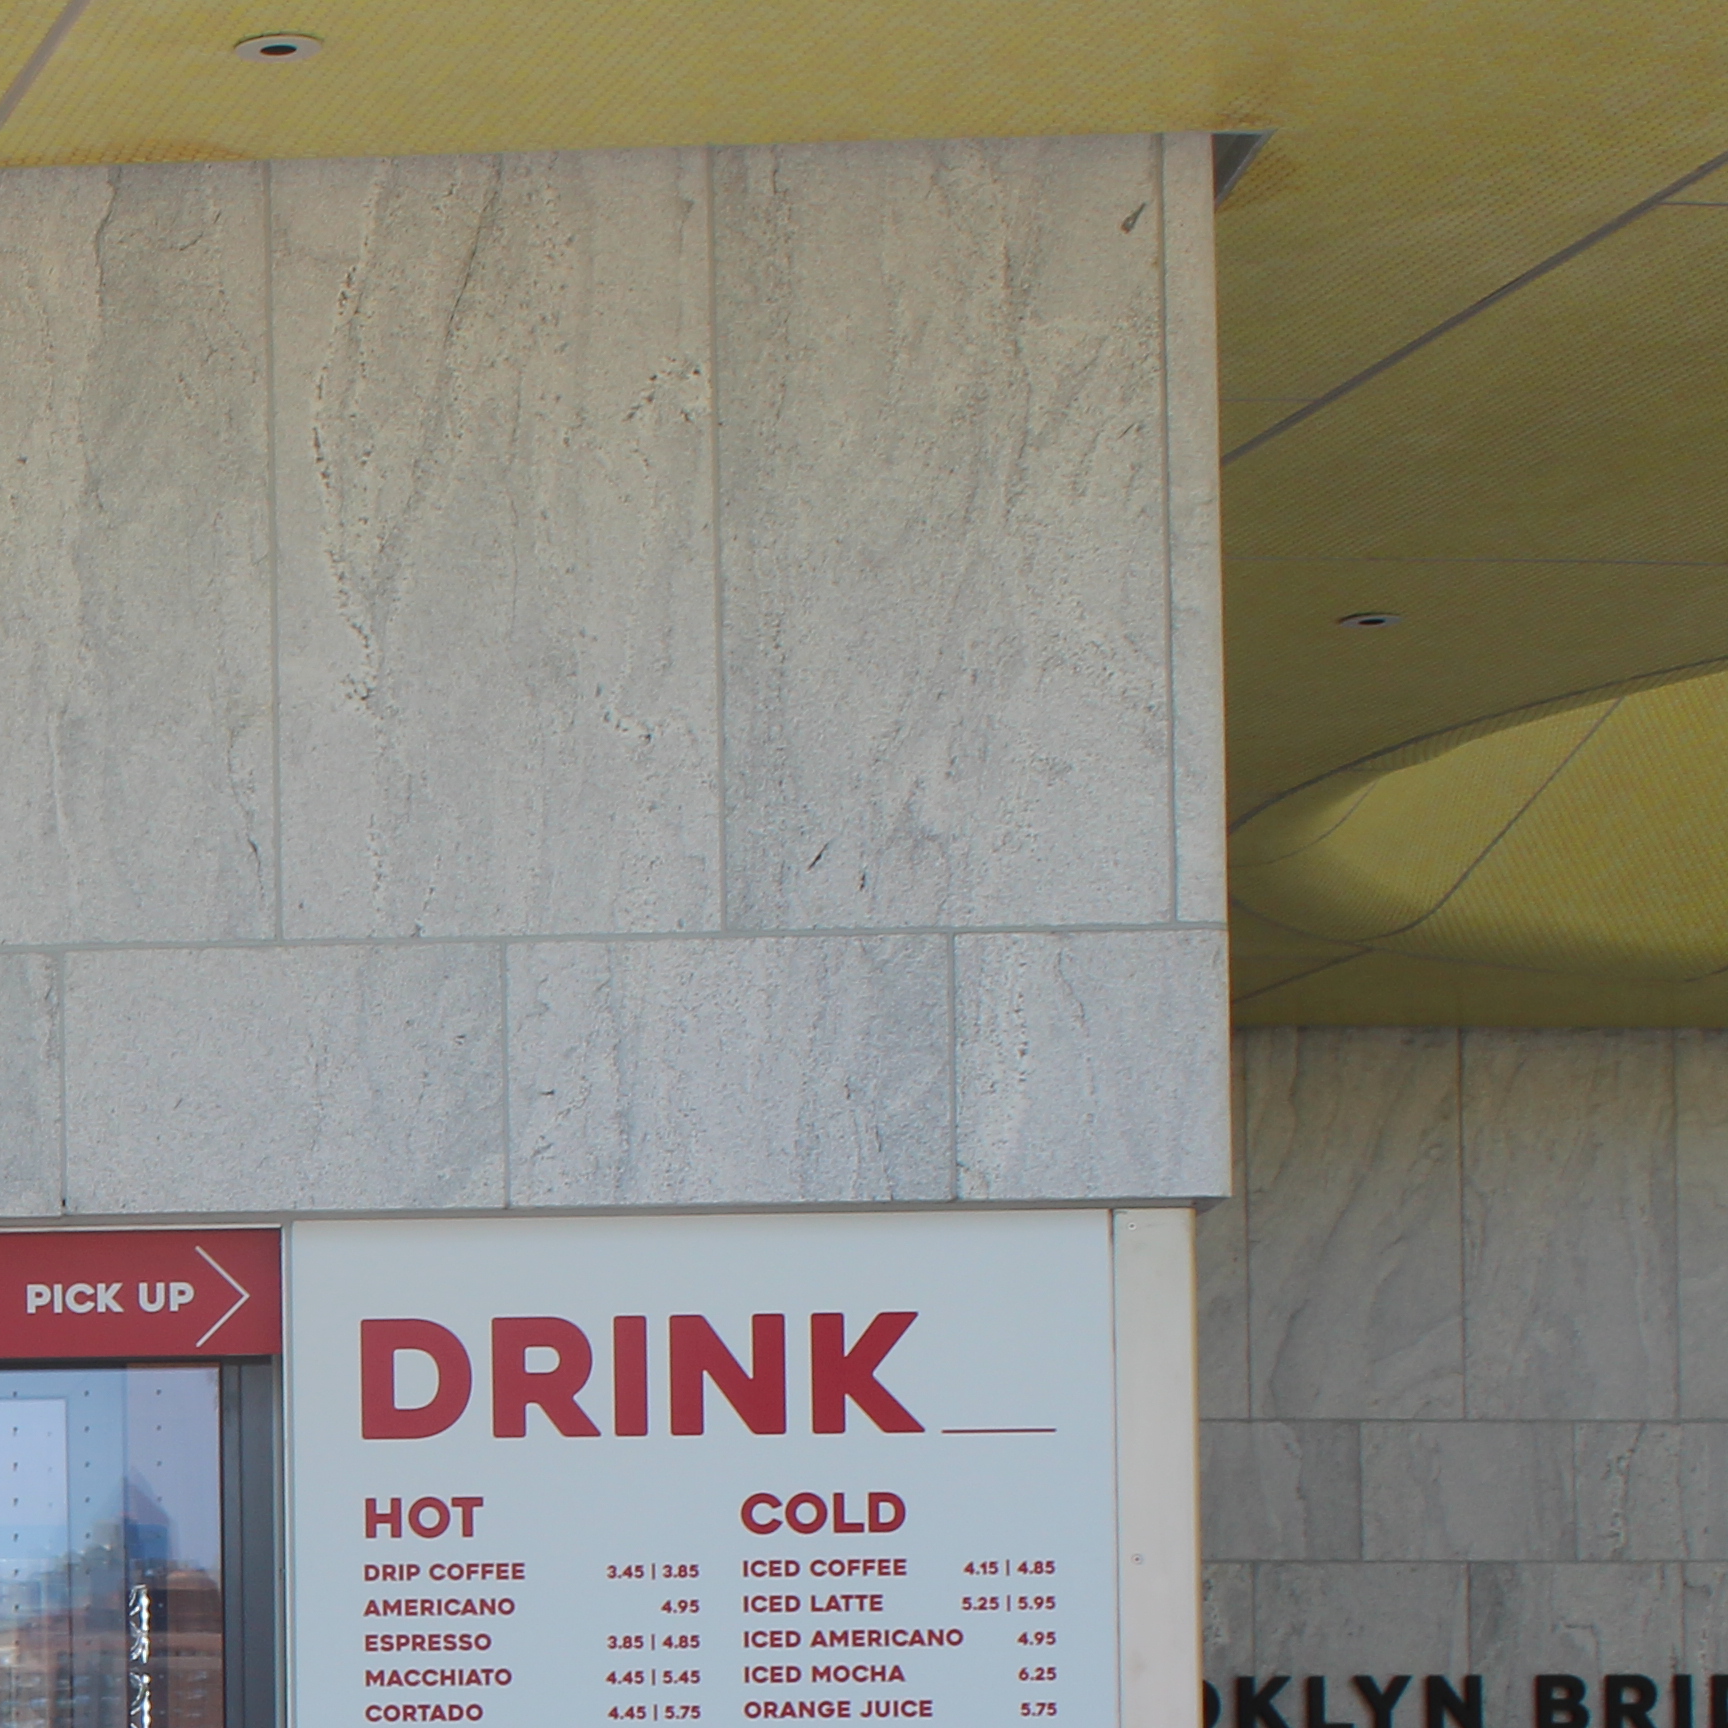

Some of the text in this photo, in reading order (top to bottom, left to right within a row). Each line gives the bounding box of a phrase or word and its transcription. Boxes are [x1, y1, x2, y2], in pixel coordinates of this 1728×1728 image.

[25, 1280, 195, 1314] PICK UP
[360, 1311, 926, 1440] DRINK
[364, 1496, 484, 1539] HOT
[740, 1491, 907, 1535] COLD
[364, 1562, 700, 1582] DRIP COFFEE 3.45 3.85
[743, 1558, 1056, 1578] ICED COFFEE 4.15 4.85
[363, 1597, 700, 1617] AMERICANO 4.95
[743, 1593, 1056, 1613] ICED LATTE 5.25 5.95
[364, 1633, 701, 1652] ESPRESSO 3.85 4.85
[743, 1628, 1057, 1649] ICED AMERICANO 4.95
[365, 1668, 701, 1687] MACCHIATO 4.45 5.45
[744, 1664, 1057, 1684] ICED MOCHA 6.25
[365, 1703, 701, 1723] CORTADO 4.45 5.75
[743, 1699, 1058, 1719] ORANGE JUICE 5.75
